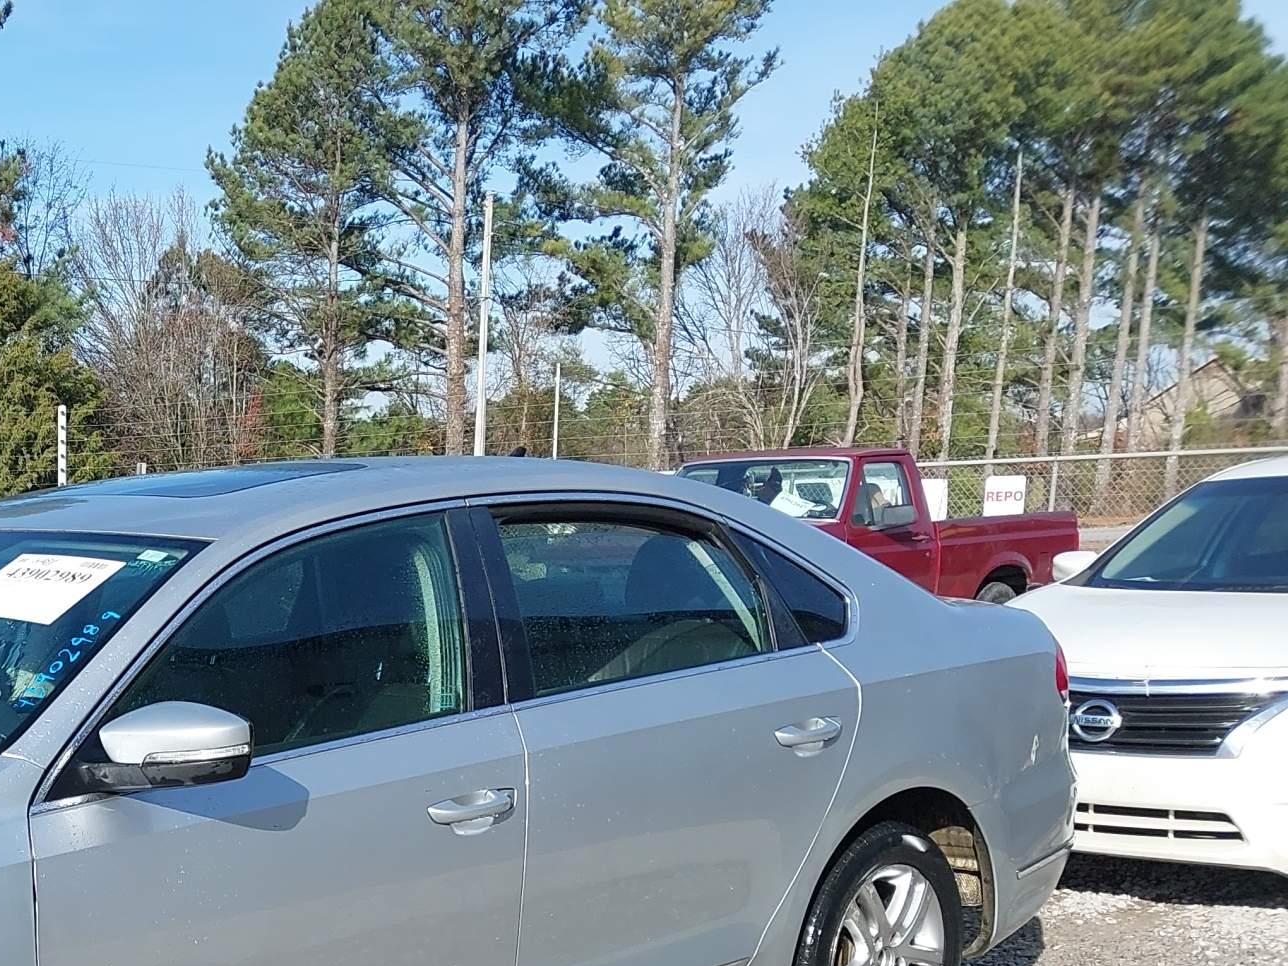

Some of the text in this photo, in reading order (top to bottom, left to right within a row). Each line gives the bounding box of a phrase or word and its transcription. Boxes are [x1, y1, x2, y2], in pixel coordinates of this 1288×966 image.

[985, 490, 1024, 502] REPO
[6, 567, 93, 584] 43902989
[1073, 714, 1114, 726] NISSAN
